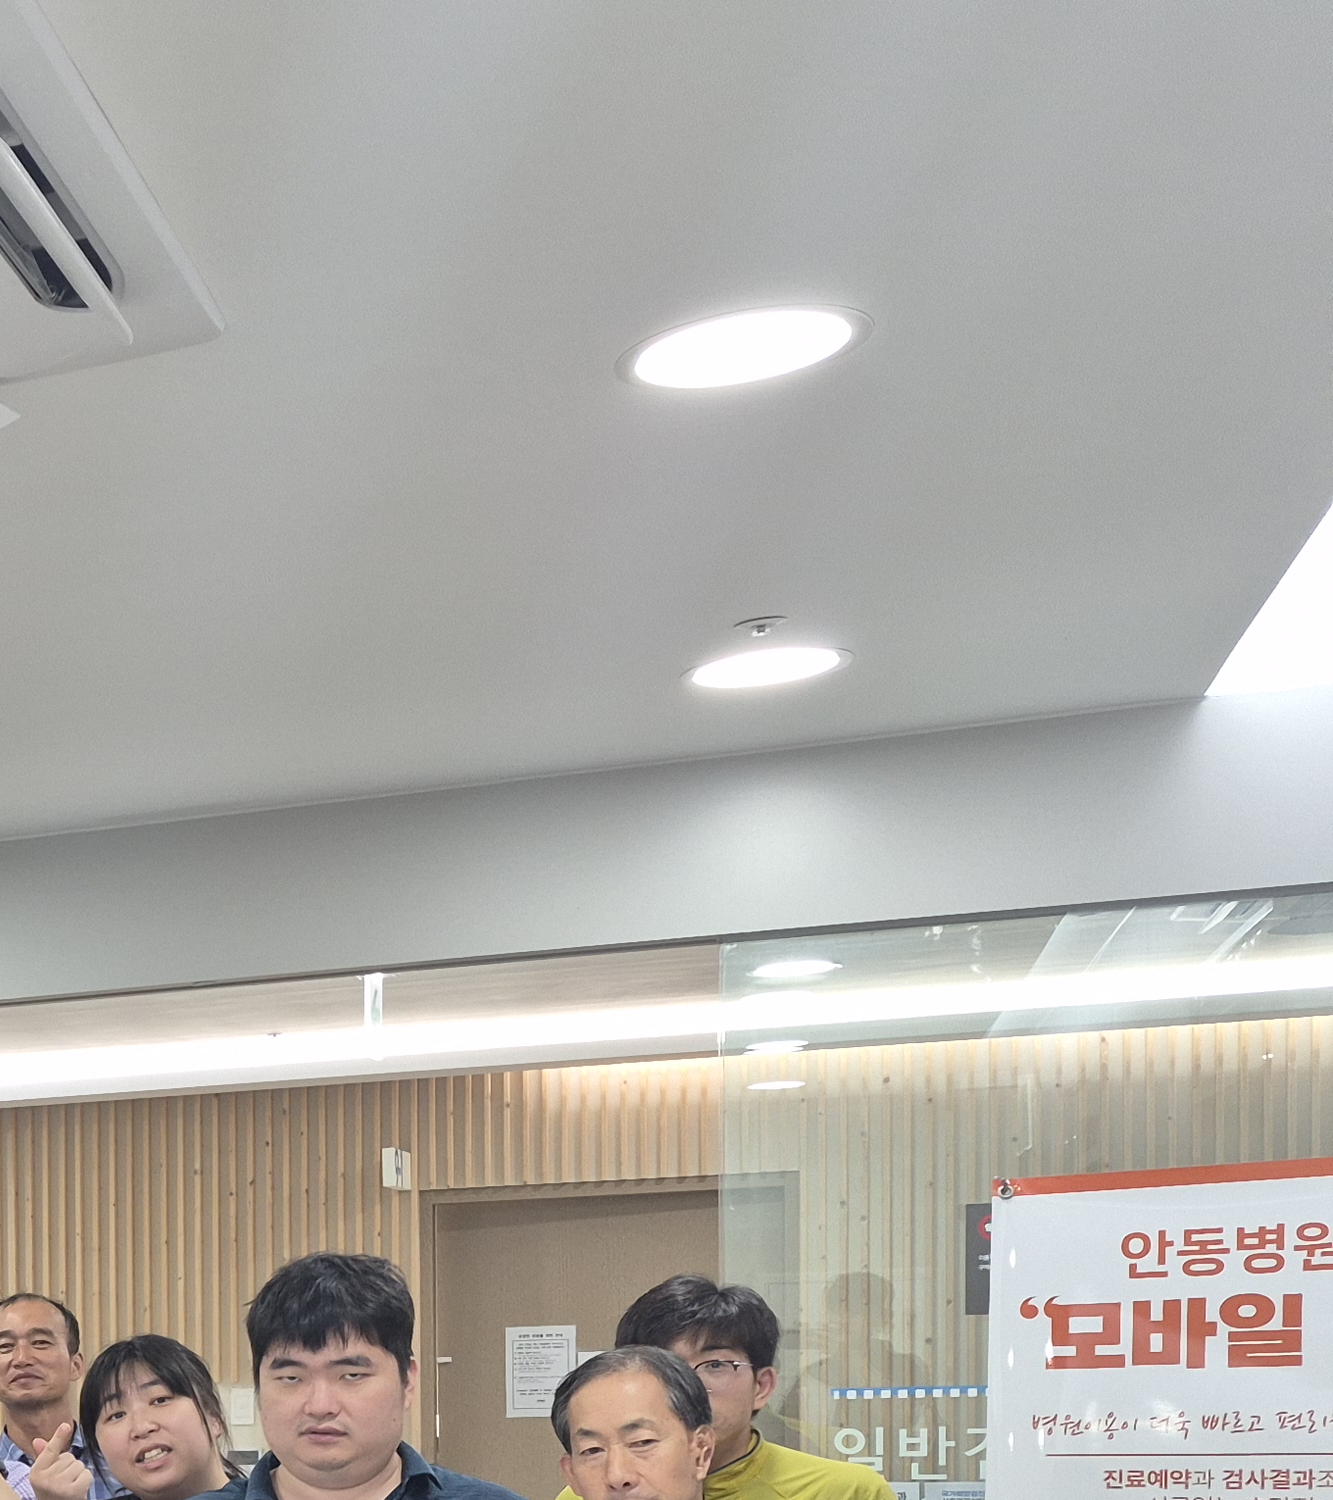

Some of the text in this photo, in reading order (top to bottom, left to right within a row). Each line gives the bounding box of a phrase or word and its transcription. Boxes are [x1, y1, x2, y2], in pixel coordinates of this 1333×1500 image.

[1121, 1222, 1333, 1279] 안동병원
[1032, 1411, 1138, 1440] 병원이용이
[1201, 1411, 1266, 1434] 빠르고
[1275, 1410, 1333, 1434] 편리
[1102, 1468, 1333, 1490] 진료예약과 검사결과조
